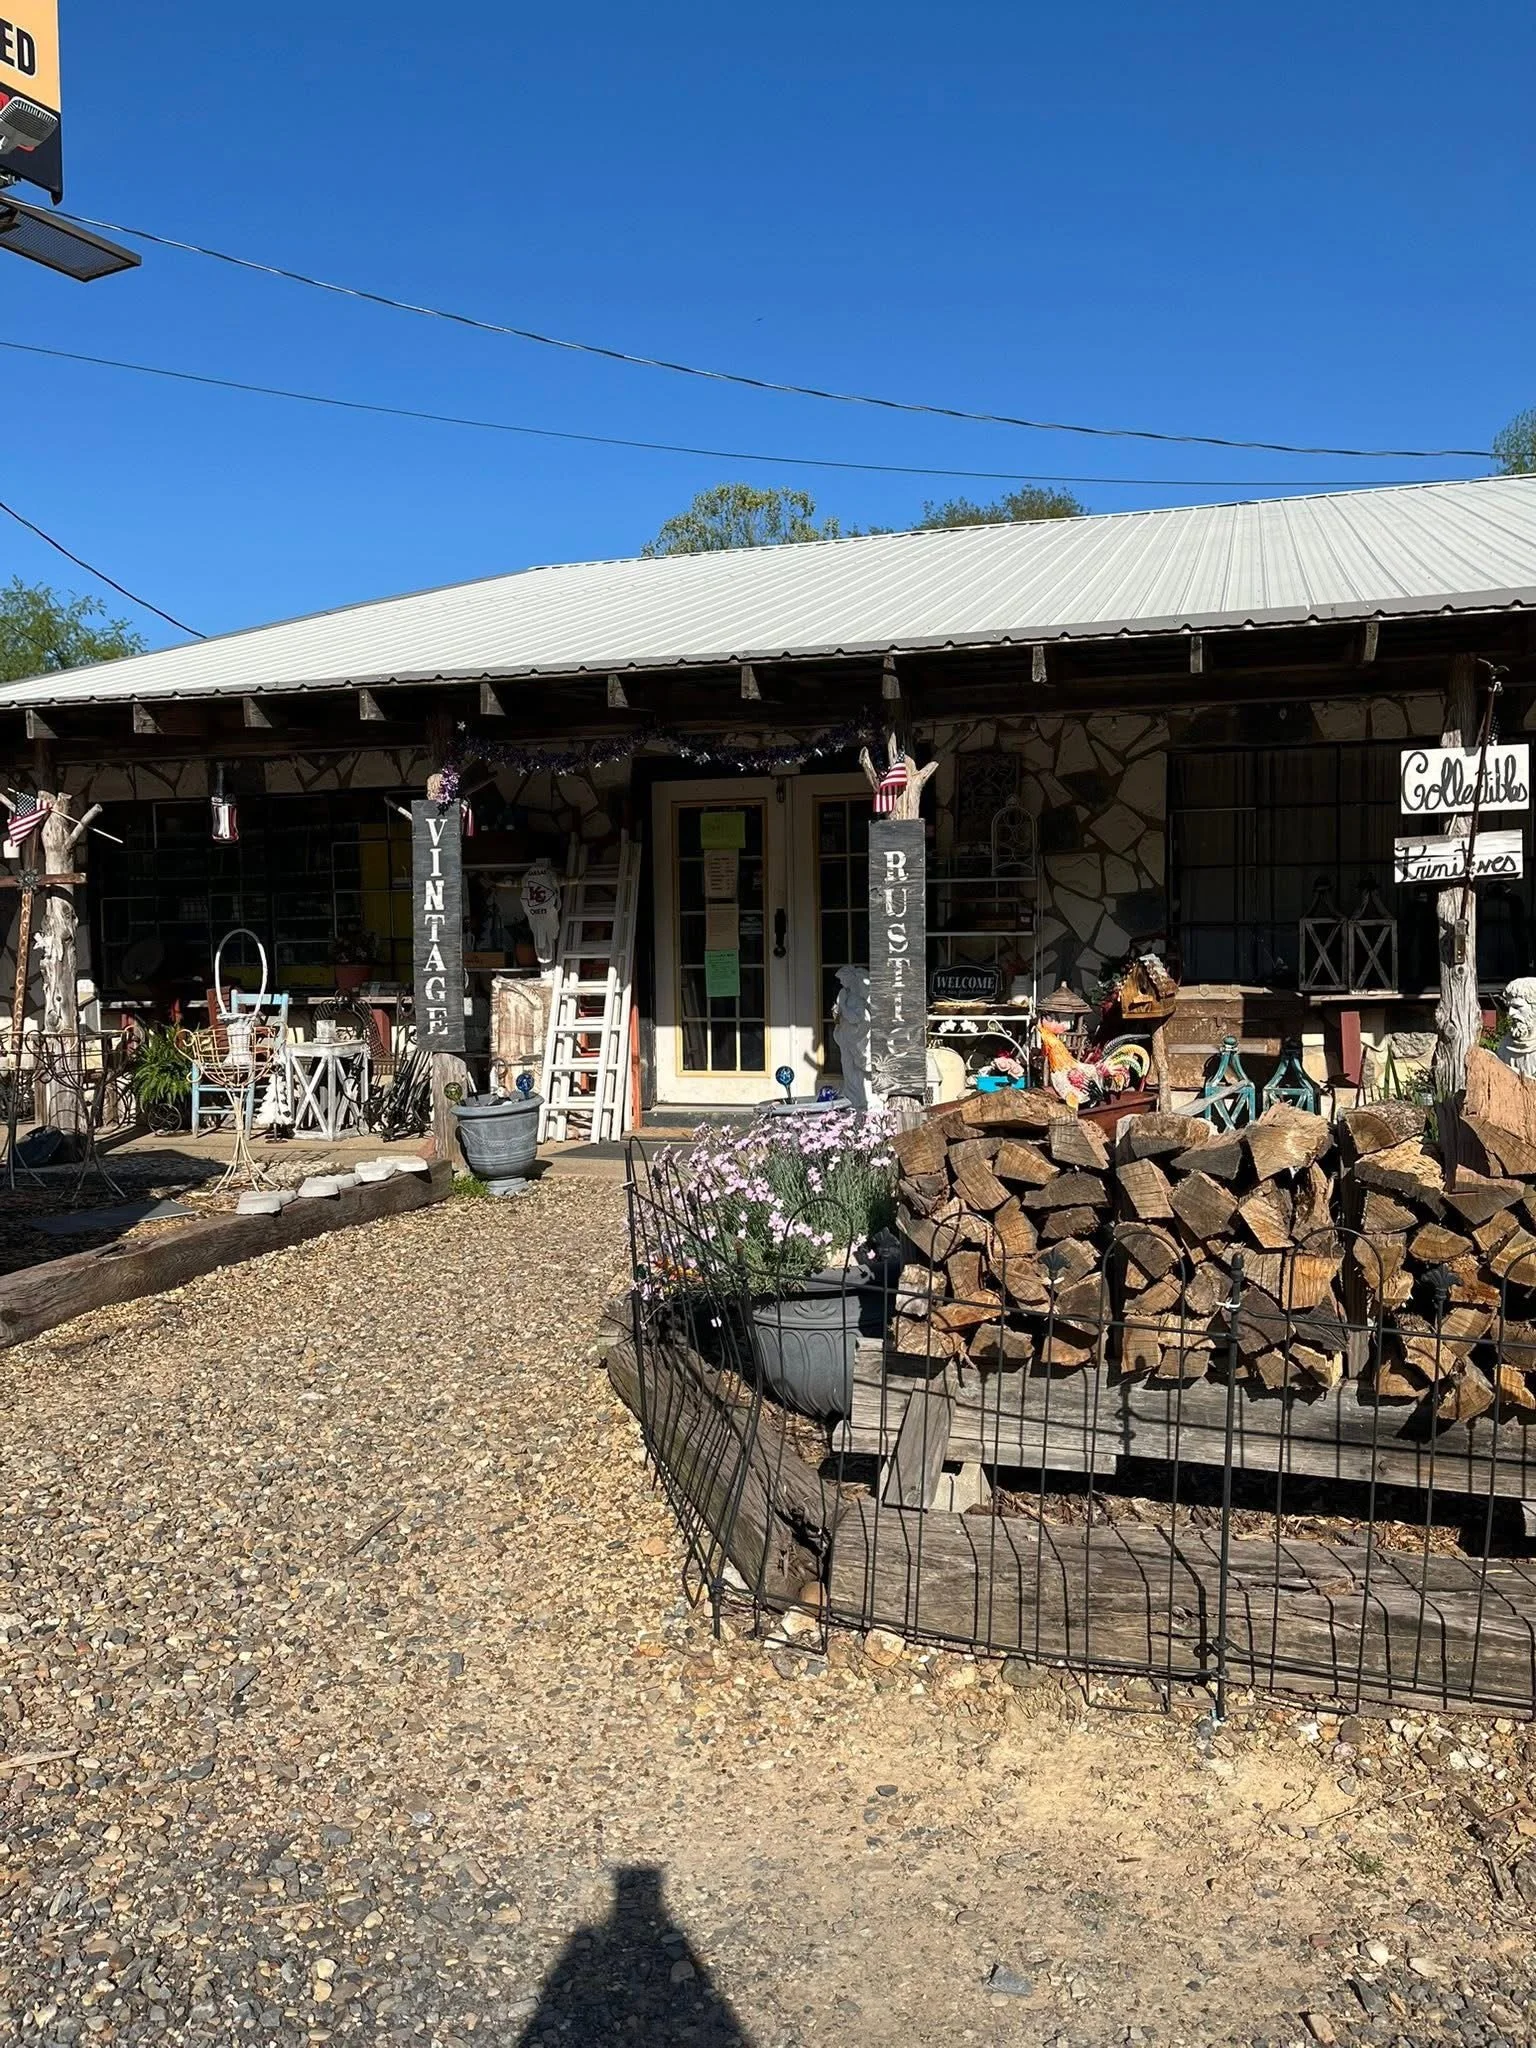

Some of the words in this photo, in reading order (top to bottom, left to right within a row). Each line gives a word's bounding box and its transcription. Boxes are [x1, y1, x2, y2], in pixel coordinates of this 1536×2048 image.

[423, 818, 449, 1036] VINTAGE
[883, 850, 911, 1058] RUSTIC
[936, 976, 995, 990] WELCOME
